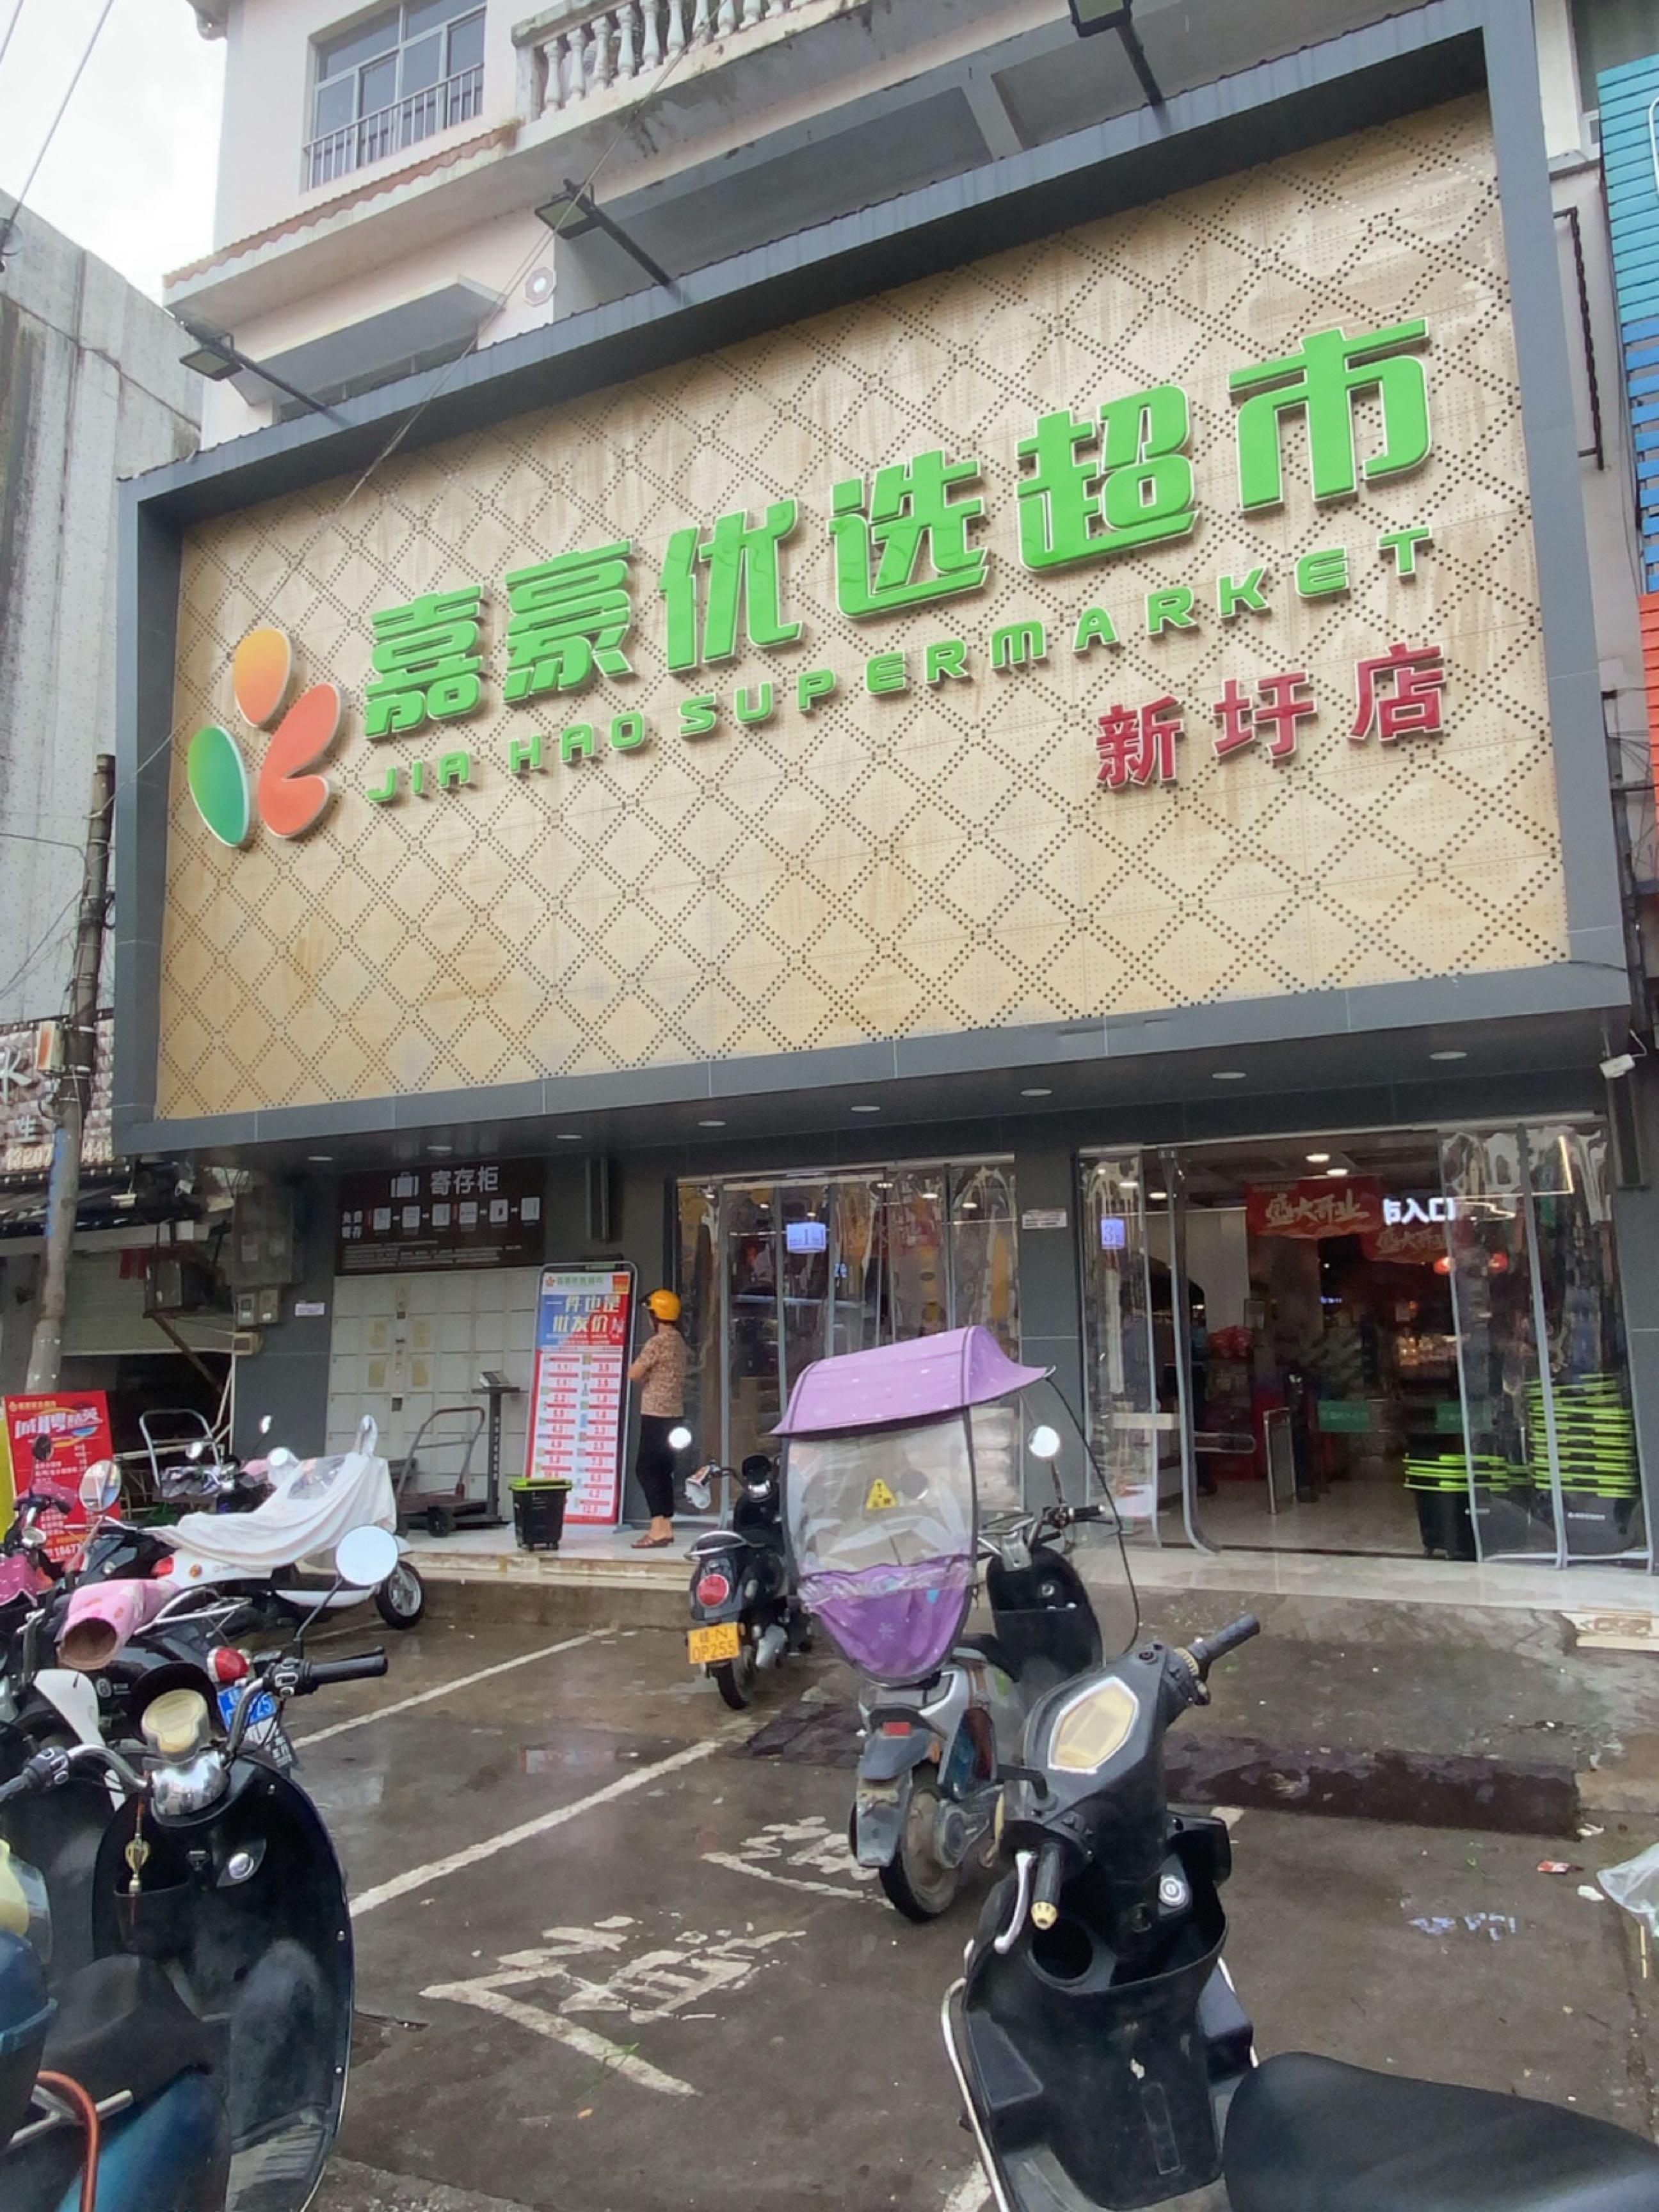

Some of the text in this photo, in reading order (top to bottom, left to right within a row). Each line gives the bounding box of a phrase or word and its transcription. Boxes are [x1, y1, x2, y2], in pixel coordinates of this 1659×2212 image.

[364, 316, 1431, 740] 嘉豪优选超市
[366, 525, 1431, 803] JIA HAO SUPERMARKET
[1095, 642, 1447, 789] 新圩店
[430, 1166, 499, 1196] 寄存柜
[1265, 1188, 1370, 1228] 盛大开业
